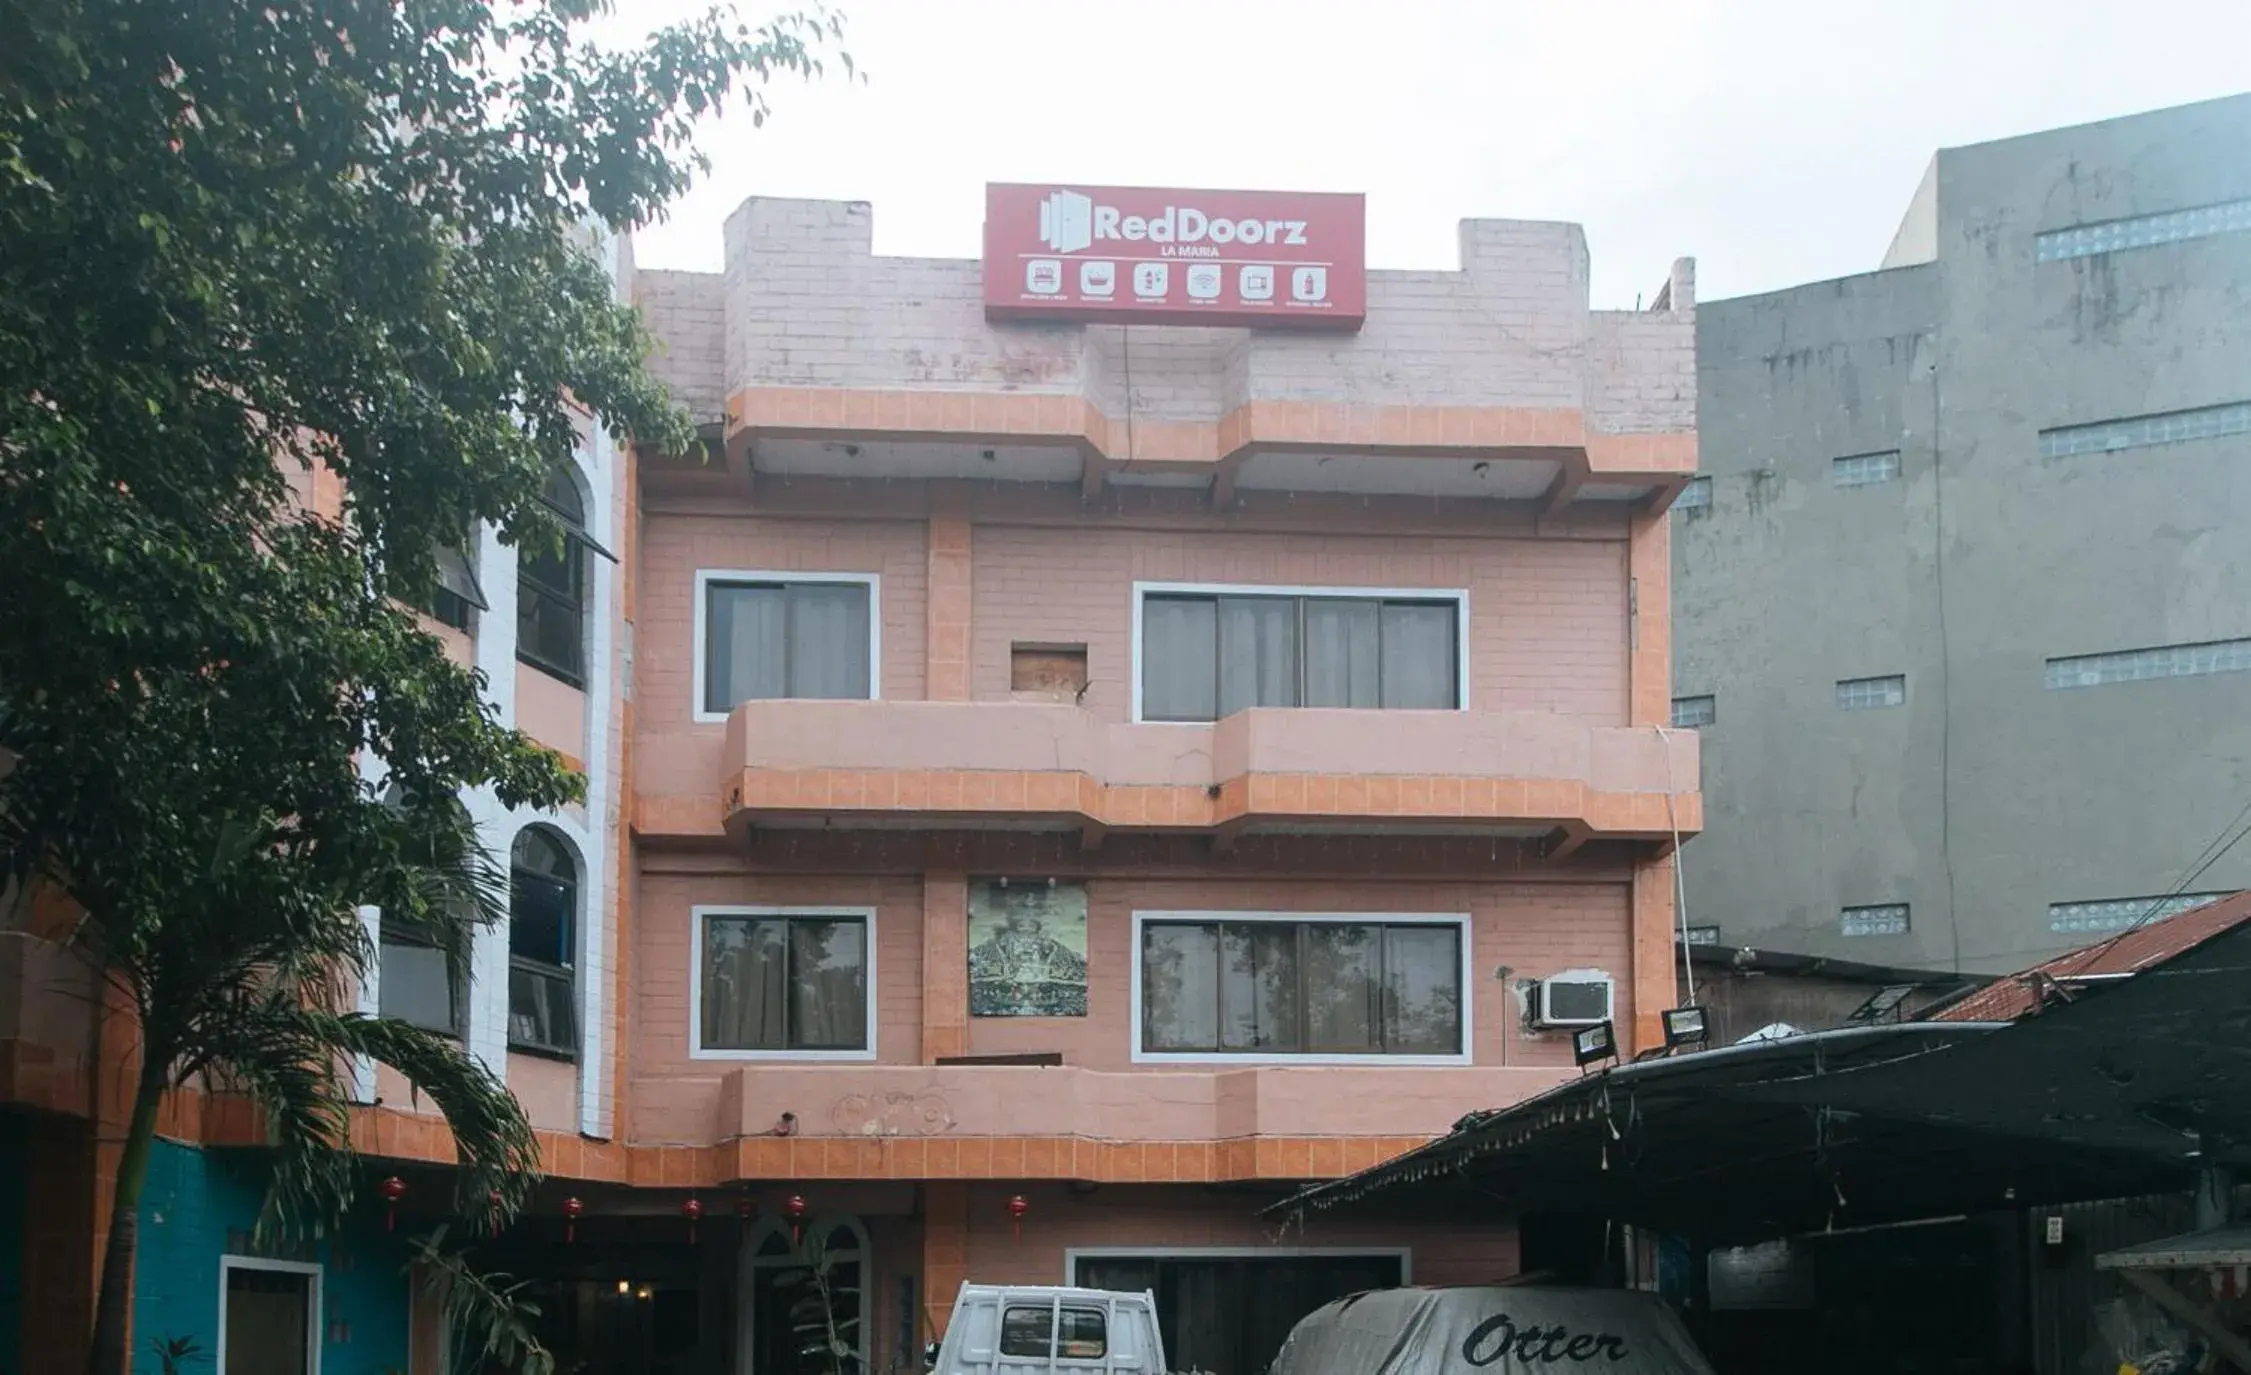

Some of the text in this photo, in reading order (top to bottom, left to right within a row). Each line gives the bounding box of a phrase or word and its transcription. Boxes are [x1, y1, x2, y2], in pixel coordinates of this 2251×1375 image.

[1094, 206, 1308, 244] RedDoorz
[1161, 245, 1220, 257] LA MARIA
[1462, 1314, 1630, 1367] Otter
